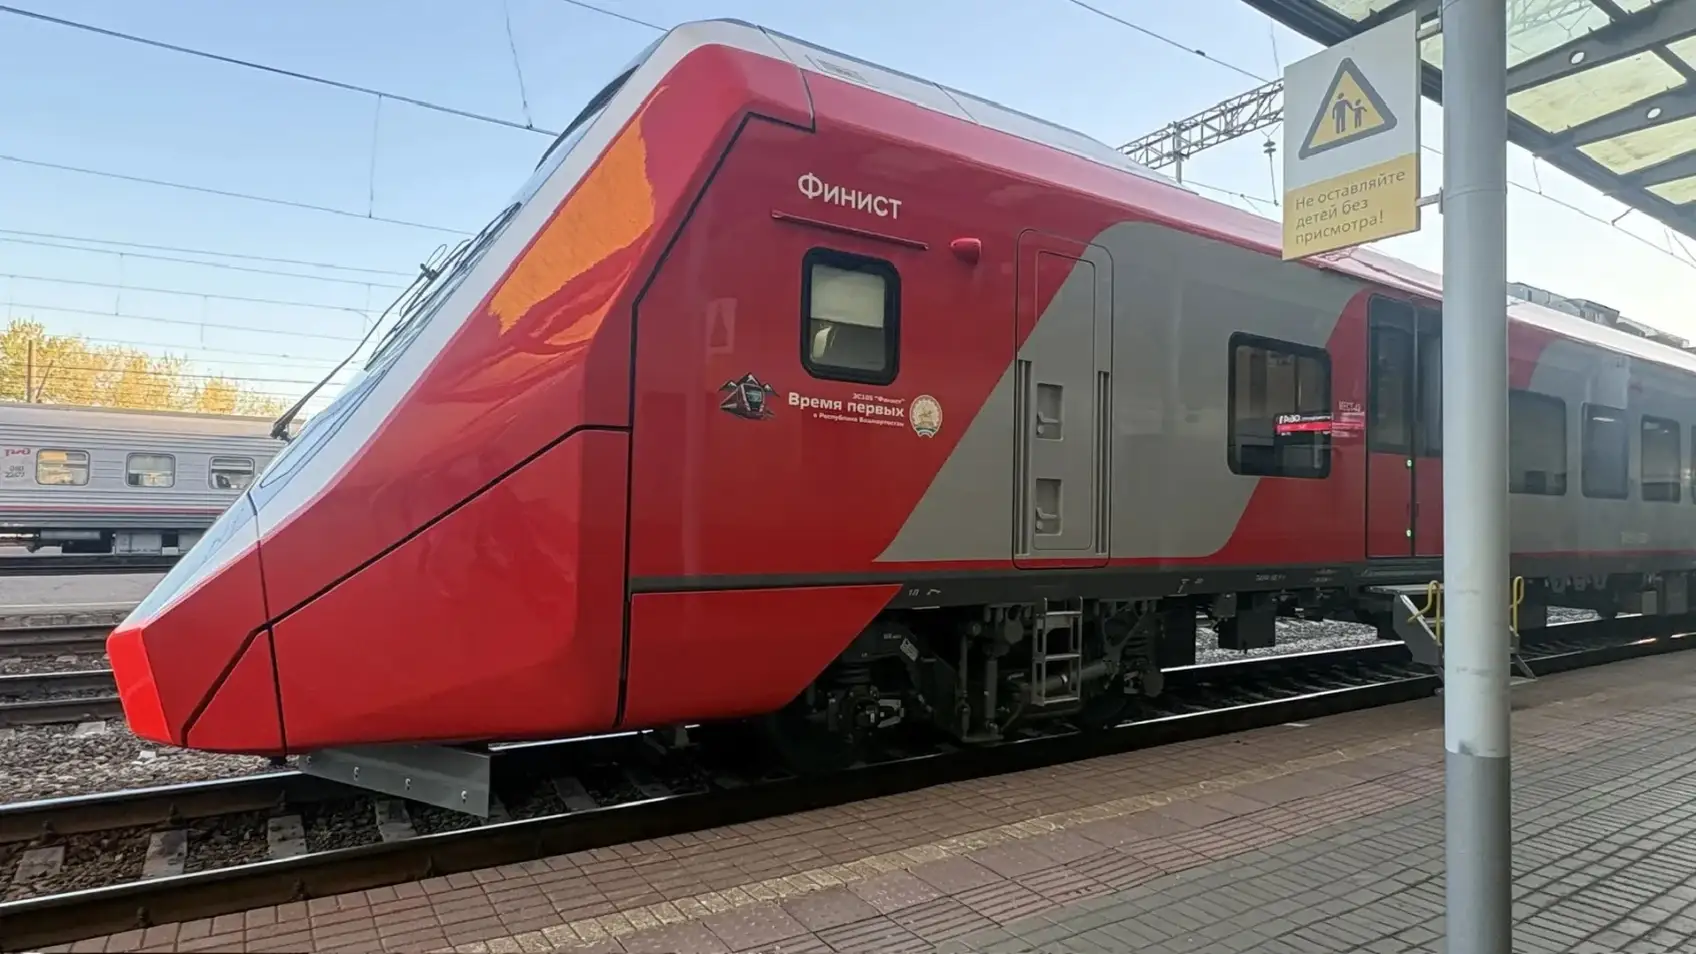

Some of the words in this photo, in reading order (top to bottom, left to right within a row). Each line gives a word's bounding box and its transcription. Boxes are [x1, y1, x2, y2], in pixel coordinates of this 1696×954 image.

[797, 171, 903, 220] Финист
[1295, 196, 1314, 210] Не
[1317, 170, 1406, 204] оставляйте
[1295, 203, 1338, 231] детей
[1342, 199, 1369, 216] без
[1295, 209, 1384, 247] присмотра!
[788, 391, 843, 411] Время
[847, 401, 905, 418] первых
